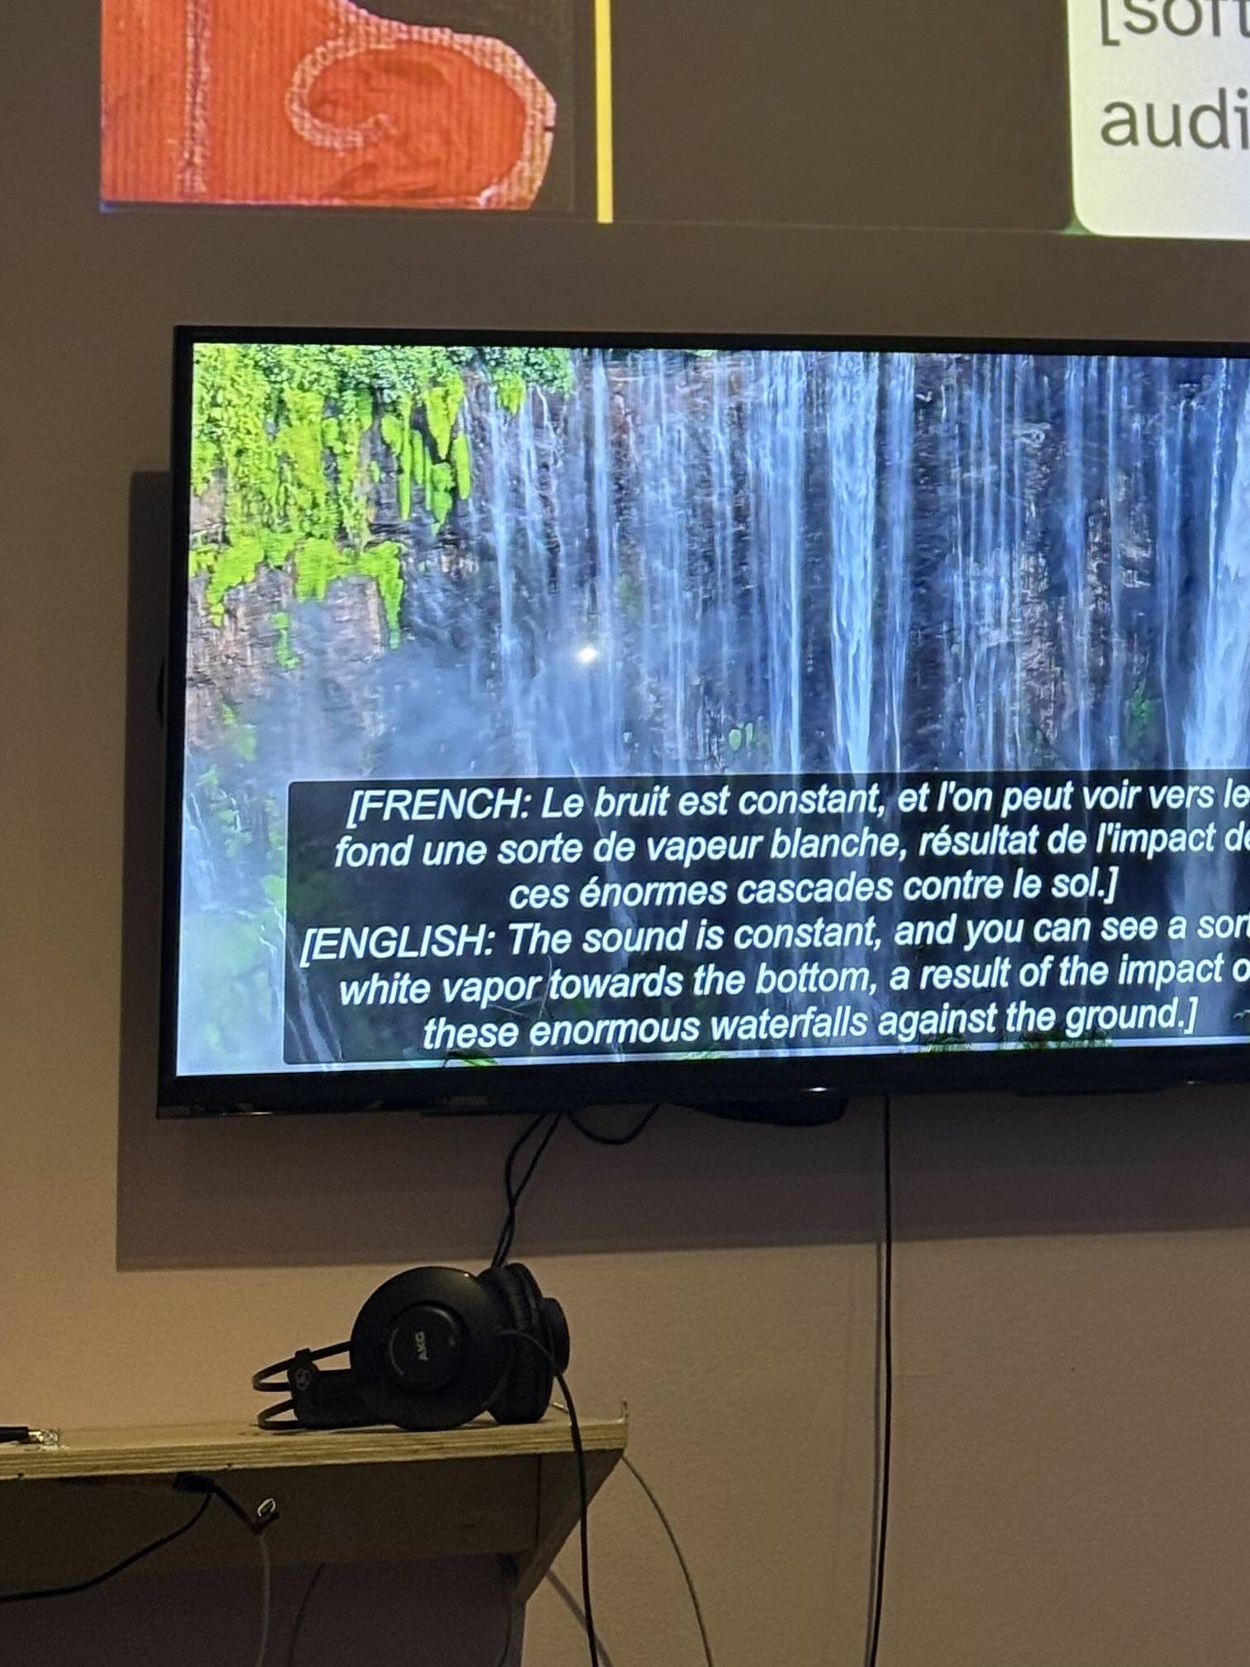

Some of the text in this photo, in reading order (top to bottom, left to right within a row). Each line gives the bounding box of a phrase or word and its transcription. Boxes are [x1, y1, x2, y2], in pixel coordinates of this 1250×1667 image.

[347, 778, 1250, 830] [FRENCH: Le bruit est constant, et l'on peut voir vers le
[333, 835, 414, 868] fond
[421, 839, 488, 866] une
[497, 835, 583, 865] sorte
[593, 831, 635, 863] de
[646, 833, 763, 868] vapeur
[770, 827, 908, 861] blanche,
[918, 824, 1043, 857] résultat
[1046, 822, 1087, 855] de
[1095, 822, 1215, 860] l'impact
[508, 865, 1120, 910] ces énormes cascades contre le sol.]
[299, 923, 496, 969] [ENGLISH:
[506, 921, 571, 956] The
[581, 920, 686, 953] sound
[695, 918, 725, 950] is
[732, 917, 883, 953] constant,
[893, 913, 957, 947] and
[962, 918, 1025, 952] you
[1032, 915, 1092, 944] can
[1100, 914, 1158, 942] see
[1167, 914, 1188, 941] a
[338, 972, 431, 1005] white
[441, 974, 544, 1010] vapor
[549, 968, 684, 1000] towards
[693, 964, 746, 995] the
[756, 962, 878, 996] bottom,
[888, 965, 910, 992] a
[918, 957, 1011, 991] result
[1018, 954, 1055, 988] of
[1059, 954, 1108, 987] the
[1117, 951, 1227, 991] impact
[423, 996, 1200, 1050] these enormous waterfalls against the ground.]
[415, 1331, 429, 1361] AKG
